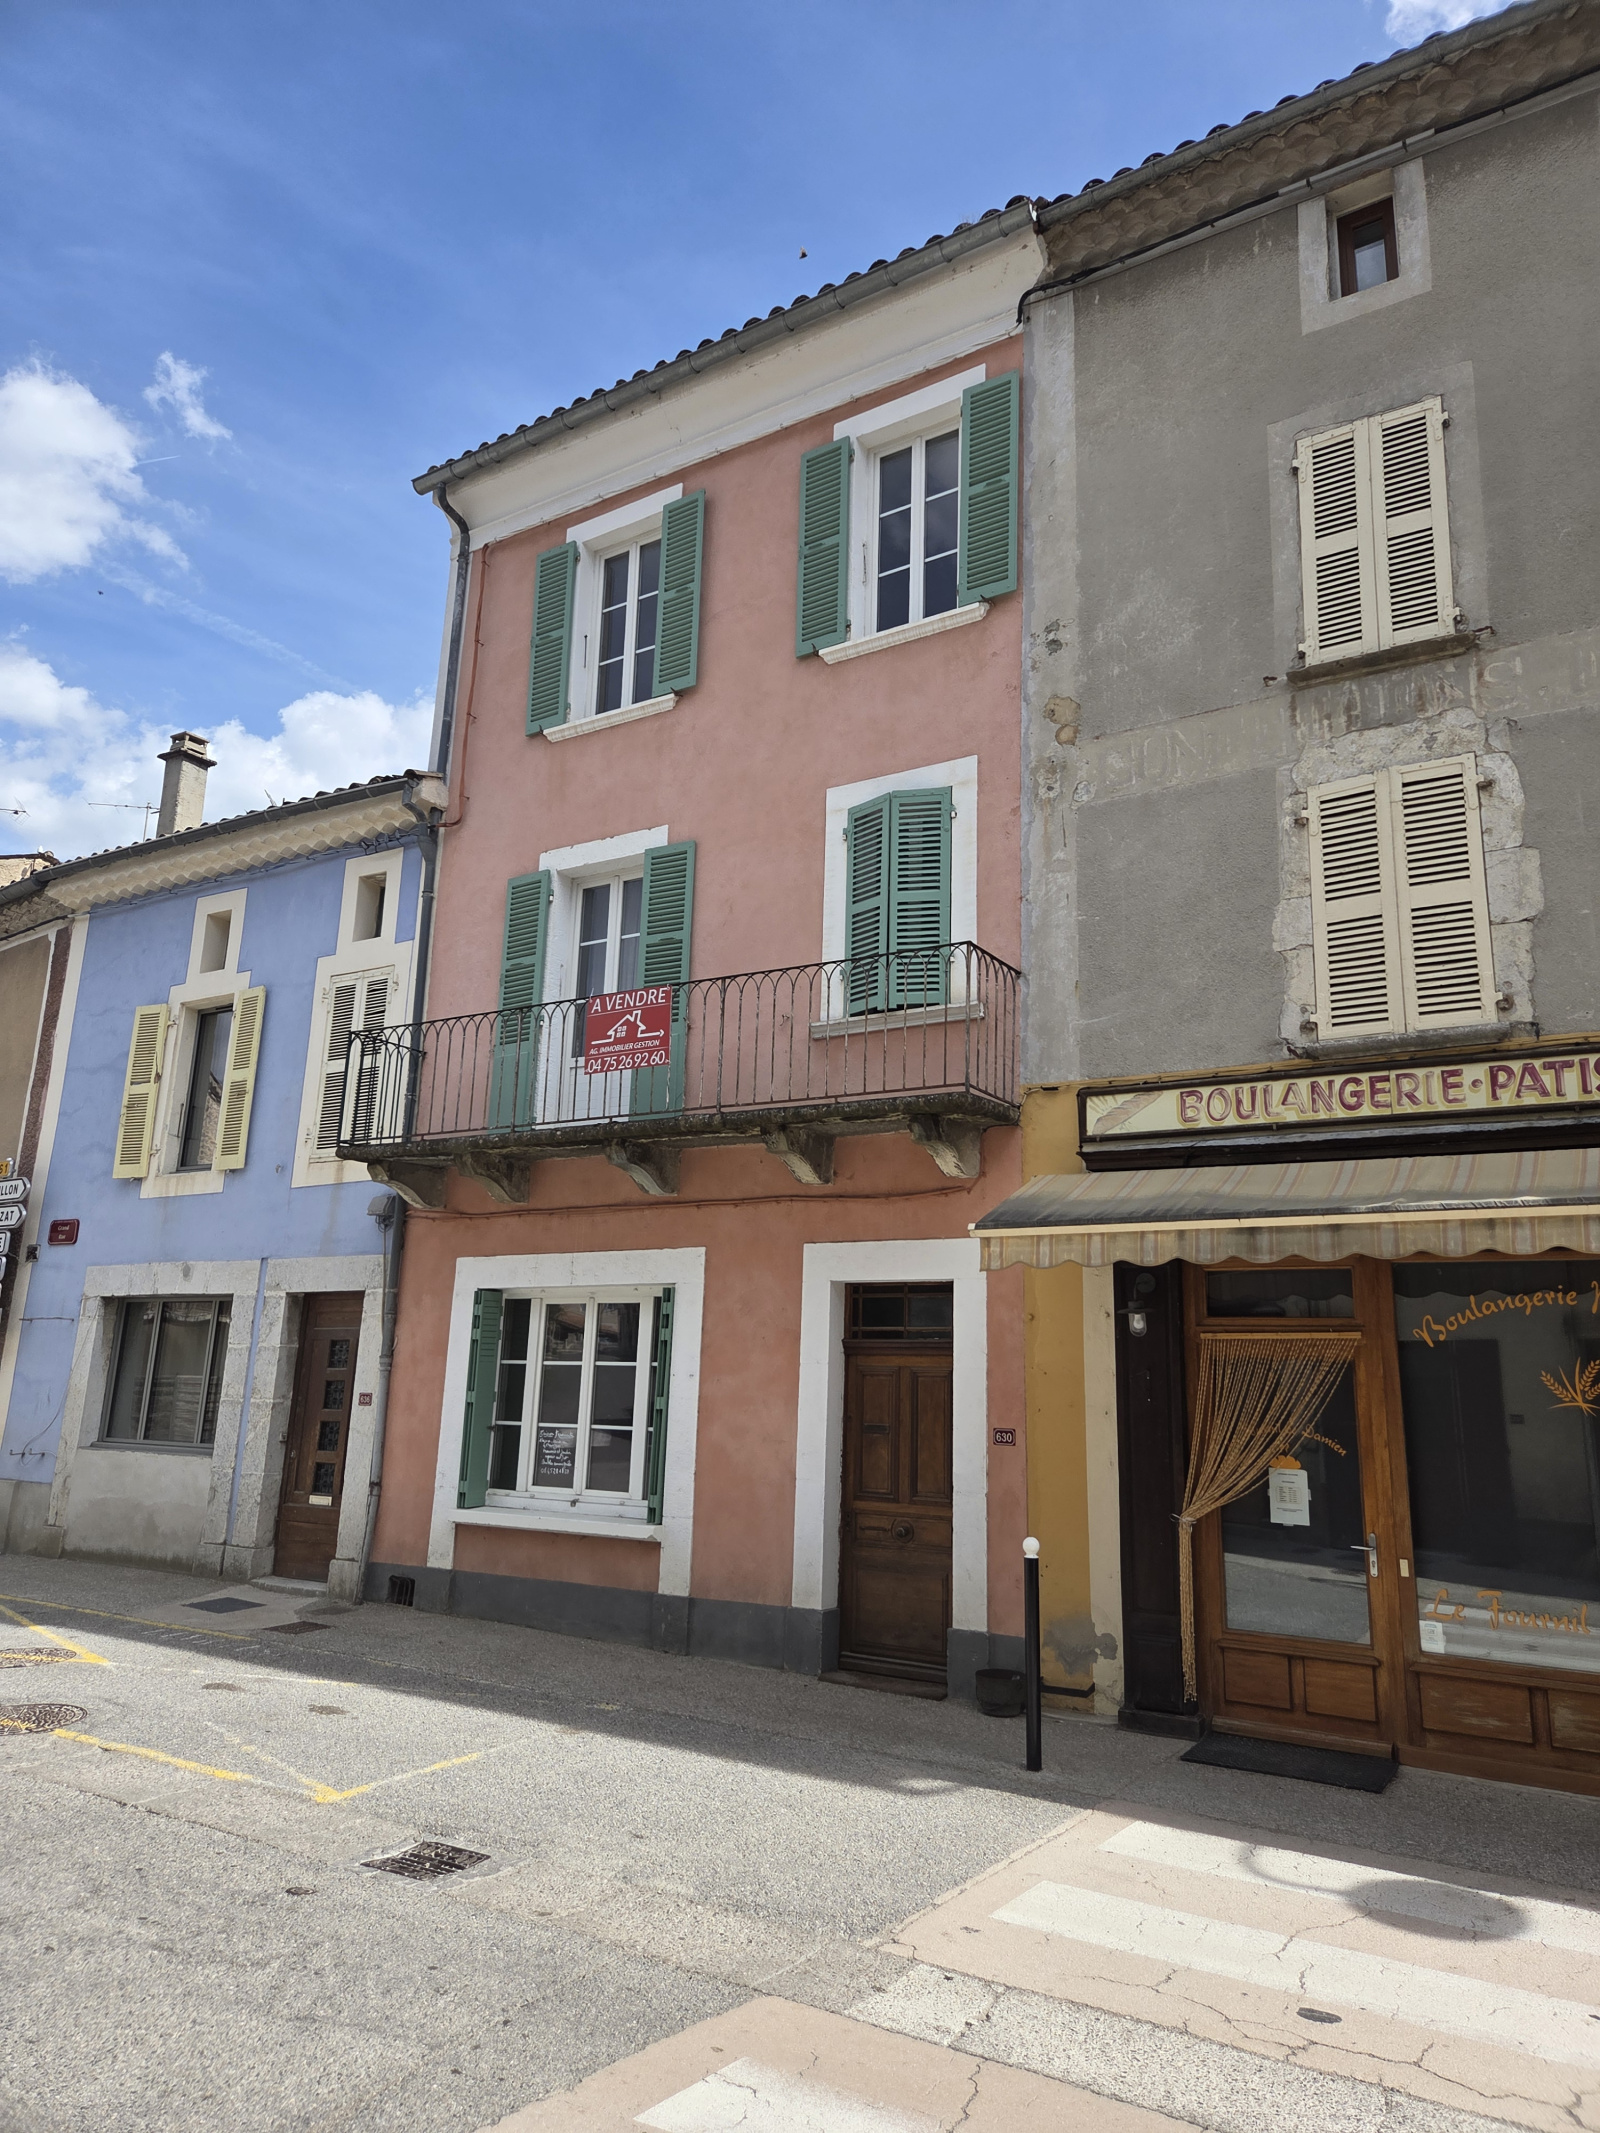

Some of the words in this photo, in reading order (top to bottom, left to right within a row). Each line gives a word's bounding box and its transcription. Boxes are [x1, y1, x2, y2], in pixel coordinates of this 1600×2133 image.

[591, 998, 601, 1013] A
[606, 987, 667, 1010] VENDRE
[600, 1042, 633, 1054] IMMOBILIER
[634, 1039, 660, 1049] GESTION
[1412, 1284, 1578, 1348] Boulangerie
[996, 1432, 1012, 1442] 630
[1301, 1423, 1347, 1457] Damien
[1426, 1588, 1466, 1621] Le
[1476, 1589, 1590, 1634] Fournil
